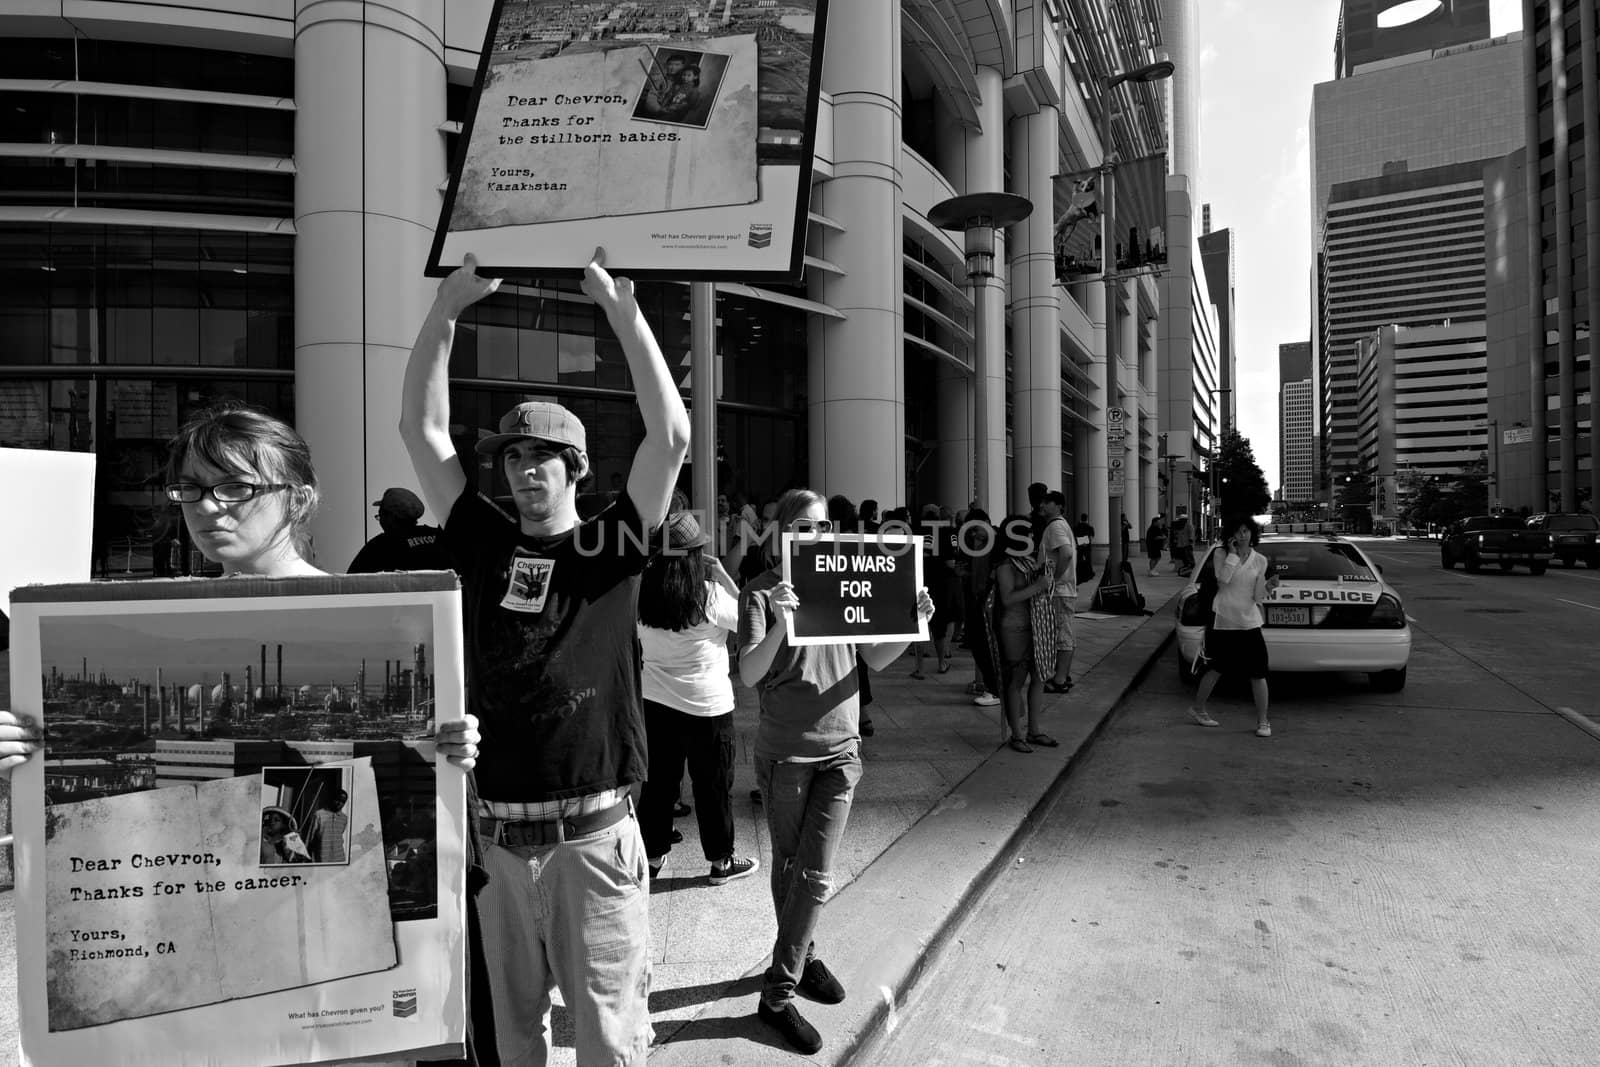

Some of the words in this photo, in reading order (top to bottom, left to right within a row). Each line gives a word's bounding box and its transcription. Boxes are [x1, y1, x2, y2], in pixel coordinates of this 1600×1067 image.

[507, 95, 548, 107] Dear
[554, 93, 628, 106] Chevron,
[502, 116, 560, 128] Thanks
[567, 114, 594, 126] for
[498, 134, 524, 145] the
[530, 132, 612, 145] stillborn
[619, 131, 682, 143] babies.
[491, 167, 535, 178] Yours,
[487, 181, 567, 192] Kazakhstan
[726, 233, 741, 241] you?
[517, 561, 551, 570] Chevron
[815, 554, 848, 572] END
[851, 555, 896, 573] WARS
[840, 581, 872, 598] FOR
[1299, 590, 1374, 602] POLICE
[844, 606, 871, 623] OIL
[70, 856, 122, 873] Dear
[131, 853, 222, 868] Chevron,
[70, 885, 144, 901] Thanks
[153, 881, 186, 896] for
[194, 878, 226, 893] the
[234, 875, 308, 891] cancer.
[70, 929, 126, 942] Yours,
[70, 945, 150, 961] Richmond,
[156, 941, 177, 955] CA
[288, 1012, 306, 1020] What
[307, 1010, 319, 1018] has
[321, 1008, 348, 1017] Chevron
[349, 1007, 368, 1016] given
[369, 1004, 385, 1014] you?
